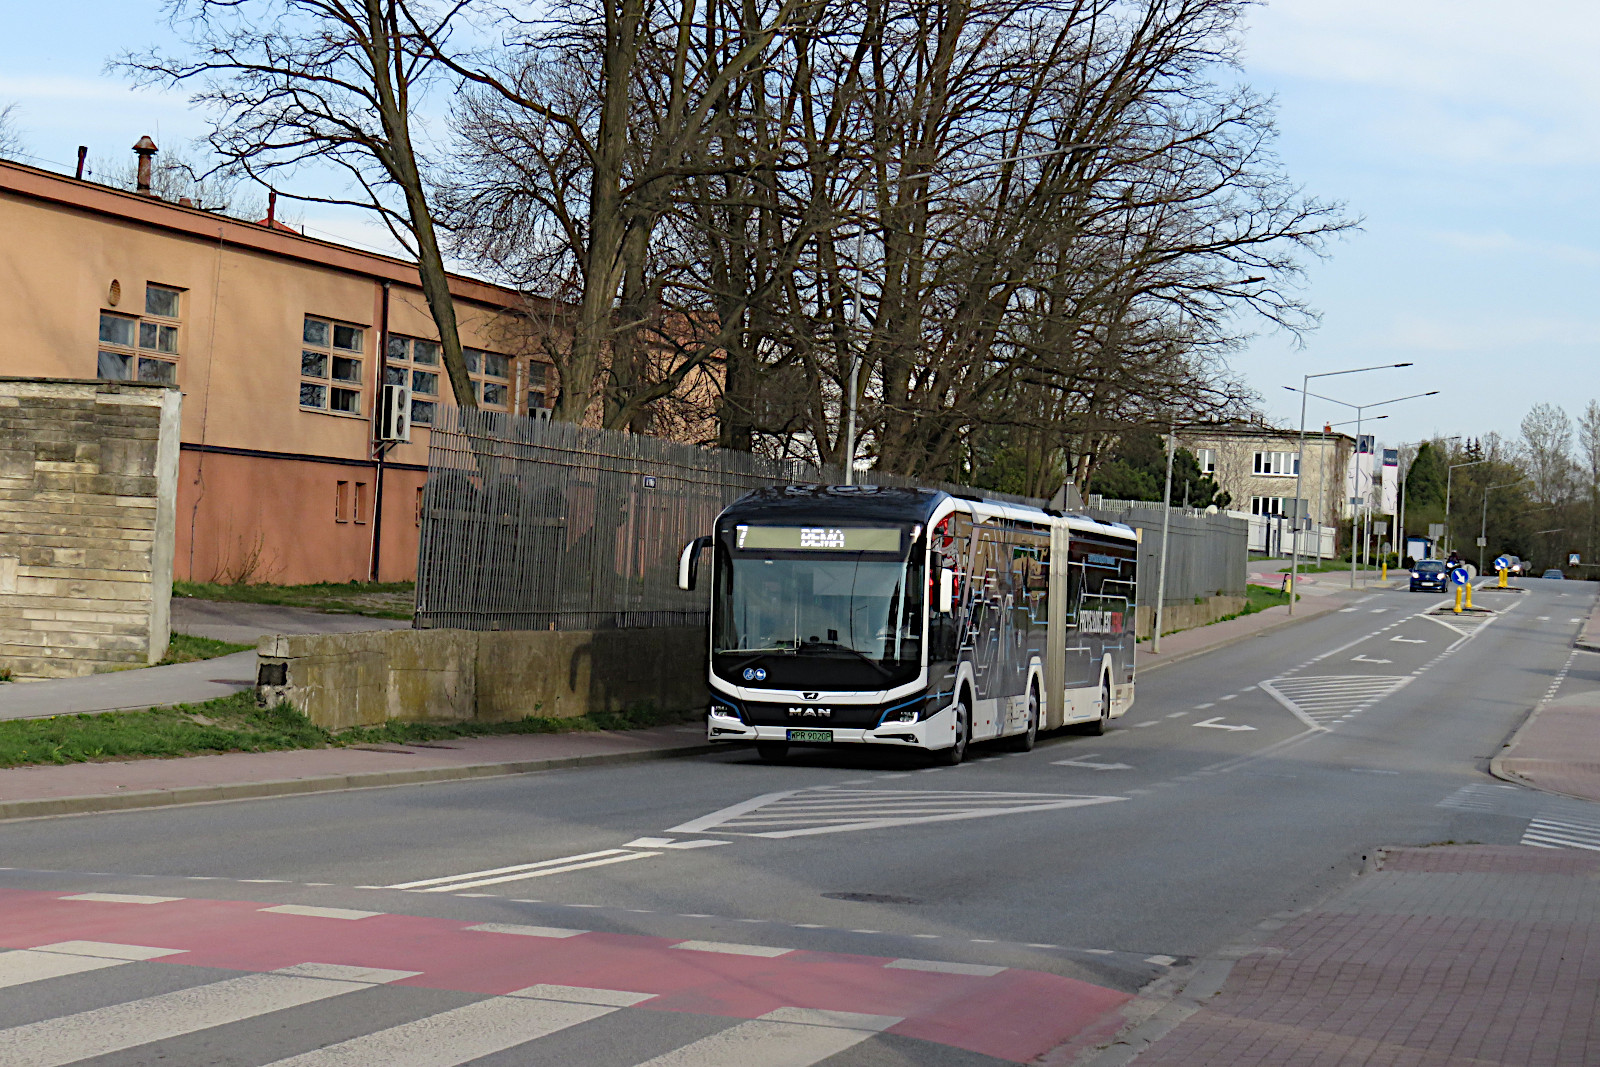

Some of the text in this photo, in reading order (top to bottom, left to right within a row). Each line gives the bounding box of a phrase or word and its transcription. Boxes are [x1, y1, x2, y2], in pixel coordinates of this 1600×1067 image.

[737, 525, 748, 548] 7
[789, 708, 831, 717] MAN
[791, 731, 805, 740] WPR
